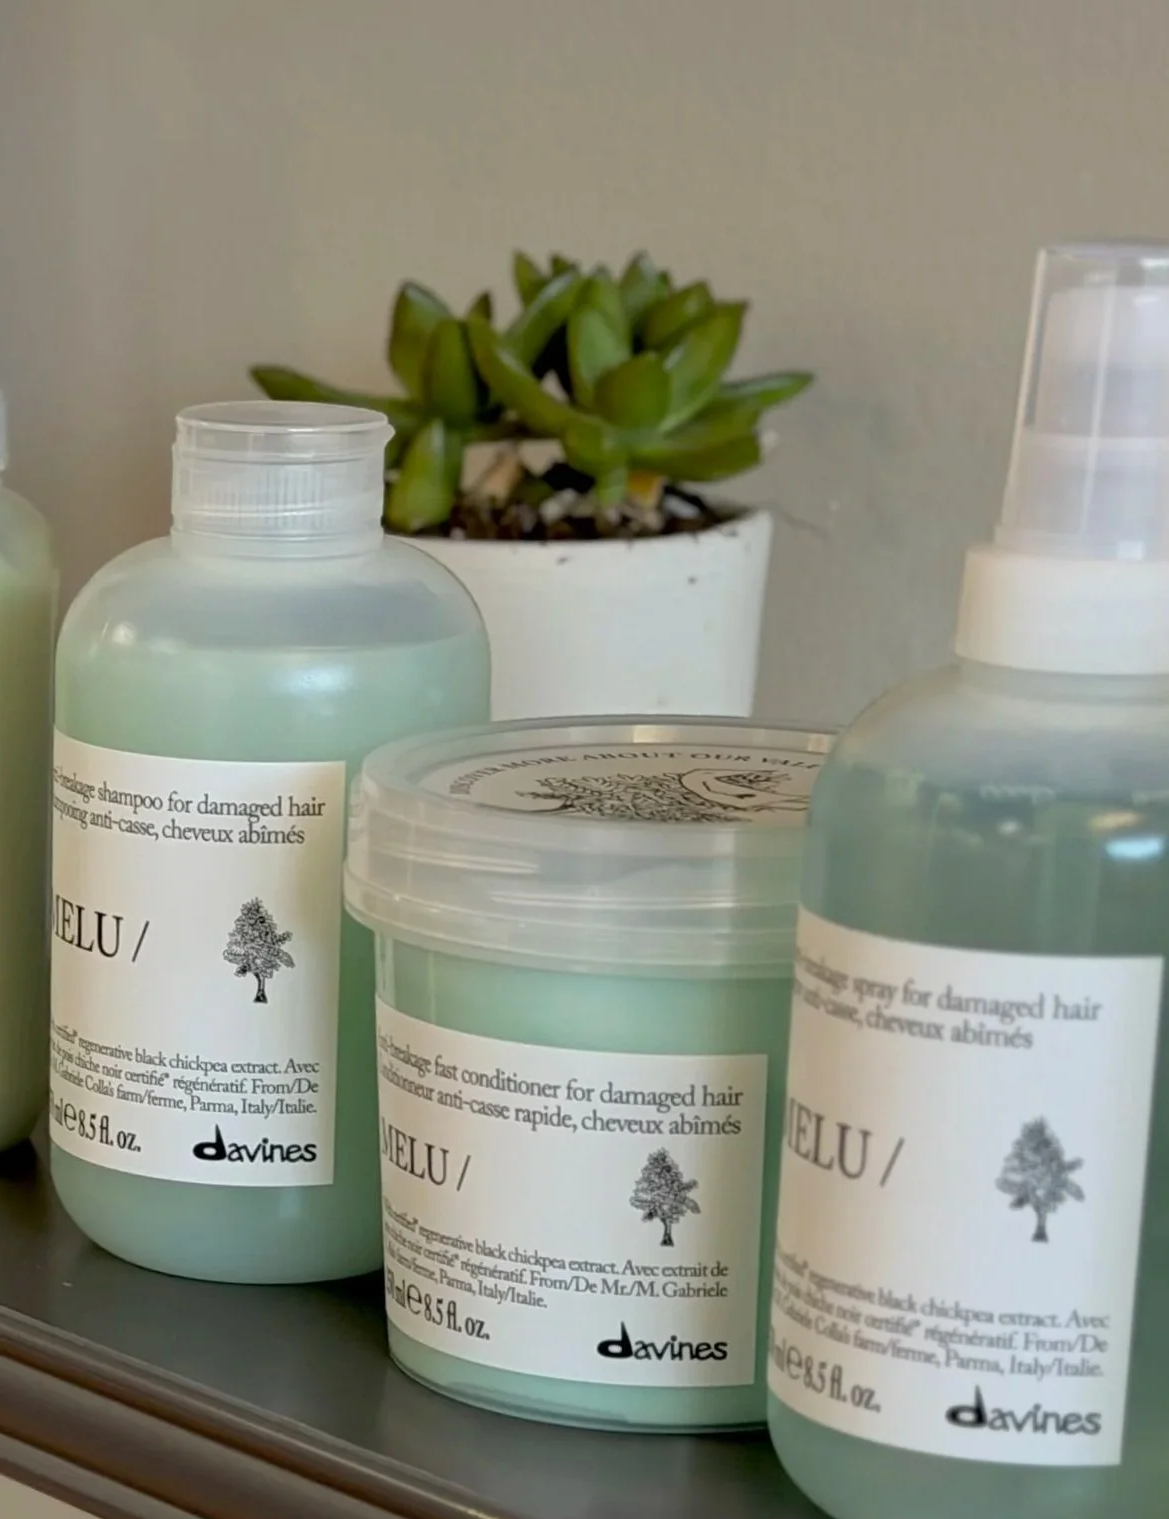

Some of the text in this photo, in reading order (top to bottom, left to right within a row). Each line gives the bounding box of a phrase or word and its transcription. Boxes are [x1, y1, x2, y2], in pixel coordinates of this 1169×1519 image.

[582, 752, 681, 762] ABOUT
[690, 752, 752, 763] OUR
[97, 781, 163, 815] shampoo
[166, 790, 193, 814] for
[197, 793, 283, 824] damaged
[287, 796, 327, 817] hair
[89, 811, 160, 841] anti-casse,
[162, 818, 233, 844] cheveux
[238, 820, 307, 845] abîmés
[901, 977, 933, 1009] for
[936, 984, 1045, 1026] damaged
[1052, 993, 1103, 1021] hair
[865, 1003, 945, 1042] cheveux
[134, 1047, 168, 1068] black
[169, 1052, 228, 1078] chickpea
[230, 1060, 281, 1075] extract.
[284, 1057, 321, 1075] Avec
[251, 1077, 319, 1095] From/De
[434, 1054, 459, 1082] fast
[461, 1068, 562, 1100] conditioner
[565, 1078, 596, 1101] for
[599, 1081, 696, 1114] damaged
[701, 1084, 745, 1107] hair
[189, 1095, 239, 1116] Parma,
[241, 1097, 318, 1119] Italy/Italie.
[436, 1089, 511, 1120] anti-casse
[514, 1104, 578, 1133] rapide,
[581, 1109, 664, 1135] cheveux
[668, 1113, 743, 1136] abîmés
[192, 1123, 318, 1163] davines
[474, 1238, 508, 1262] black
[508, 1246, 566, 1273] chickpea
[567, 1258, 619, 1275] extract.
[621, 1259, 660, 1276] Avec
[661, 1262, 708, 1278] extrait
[710, 1260, 729, 1278] de
[529, 1270, 597, 1294] From/De
[661, 1281, 729, 1298] Gabriele
[464, 1316, 491, 1341] oz.
[919, 1297, 994, 1328] chickpea
[1063, 1308, 1111, 1330] Avec
[595, 1320, 729, 1361] davines
[1022, 1321, 1110, 1354] From/De
[944, 1383, 1103, 1436] davines
